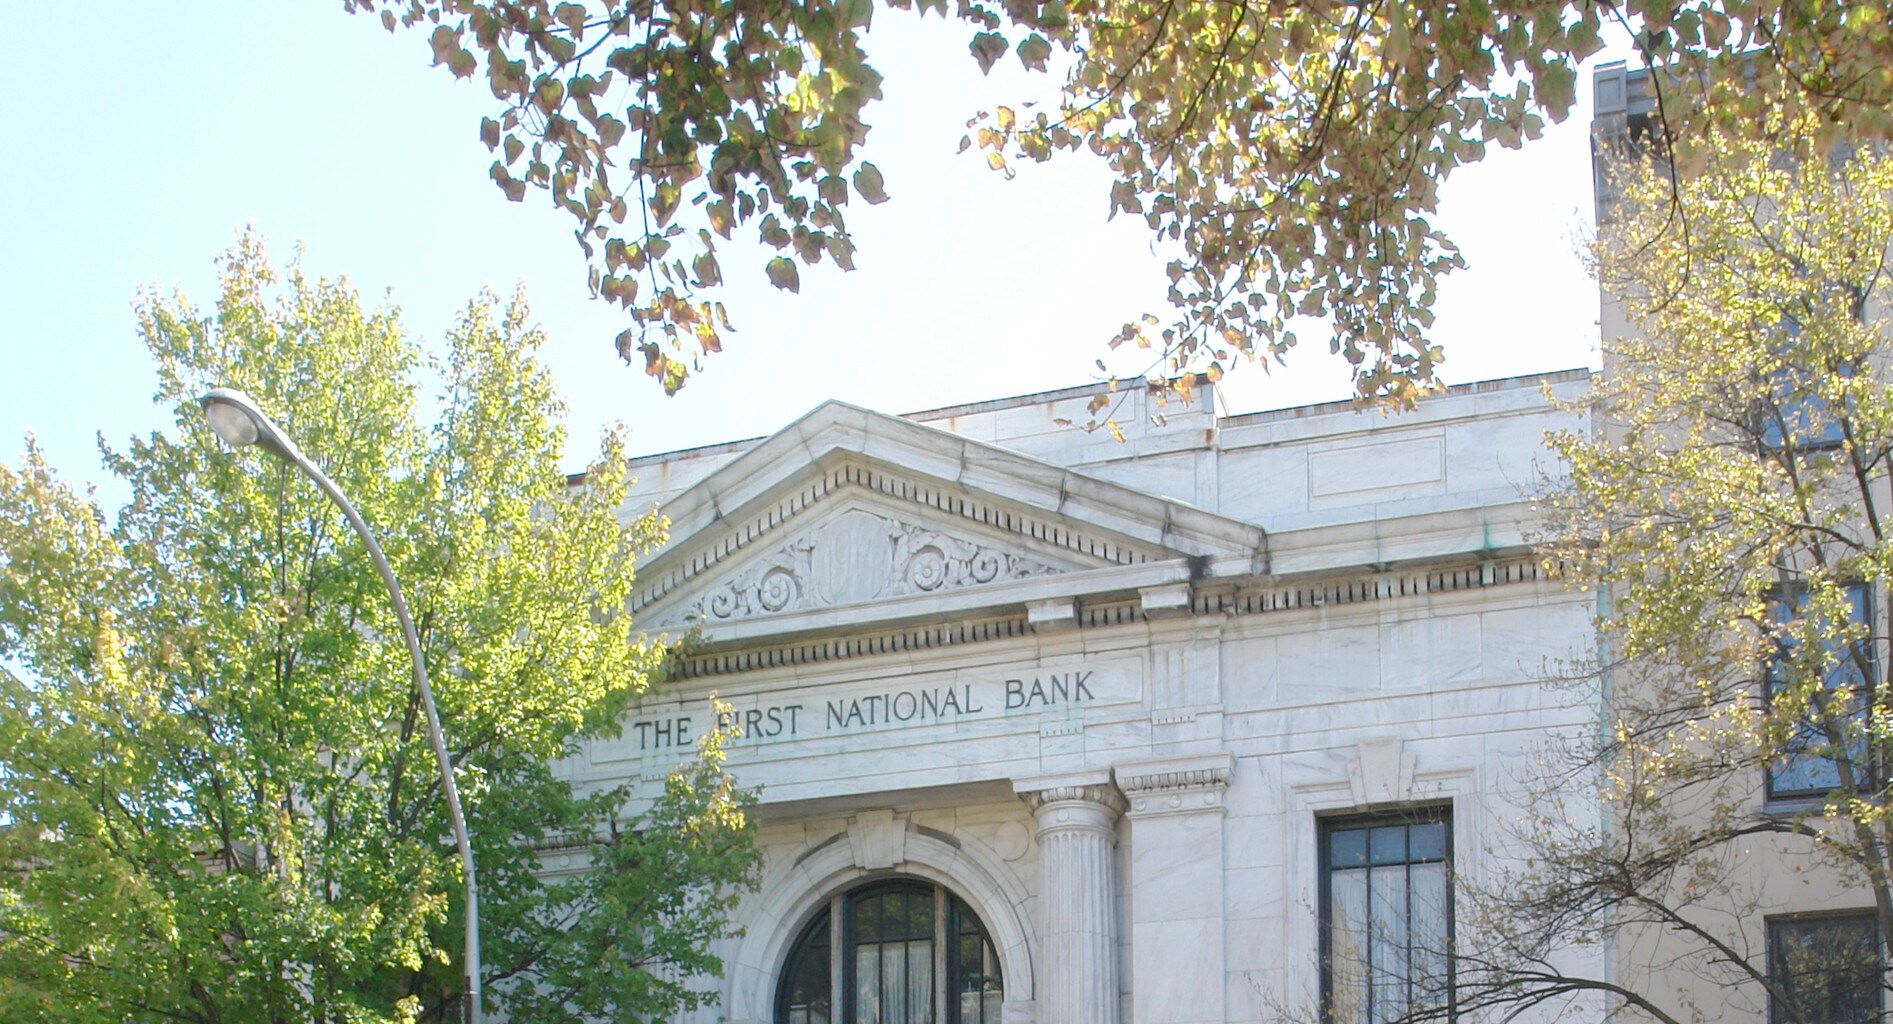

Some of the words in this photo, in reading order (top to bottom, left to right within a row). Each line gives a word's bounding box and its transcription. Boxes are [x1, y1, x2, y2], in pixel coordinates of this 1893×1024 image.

[633, 717, 693, 750] THE
[717, 704, 804, 745] FIRST
[826, 684, 983, 730] NATIONAL
[1004, 670, 1095, 710] BANK
